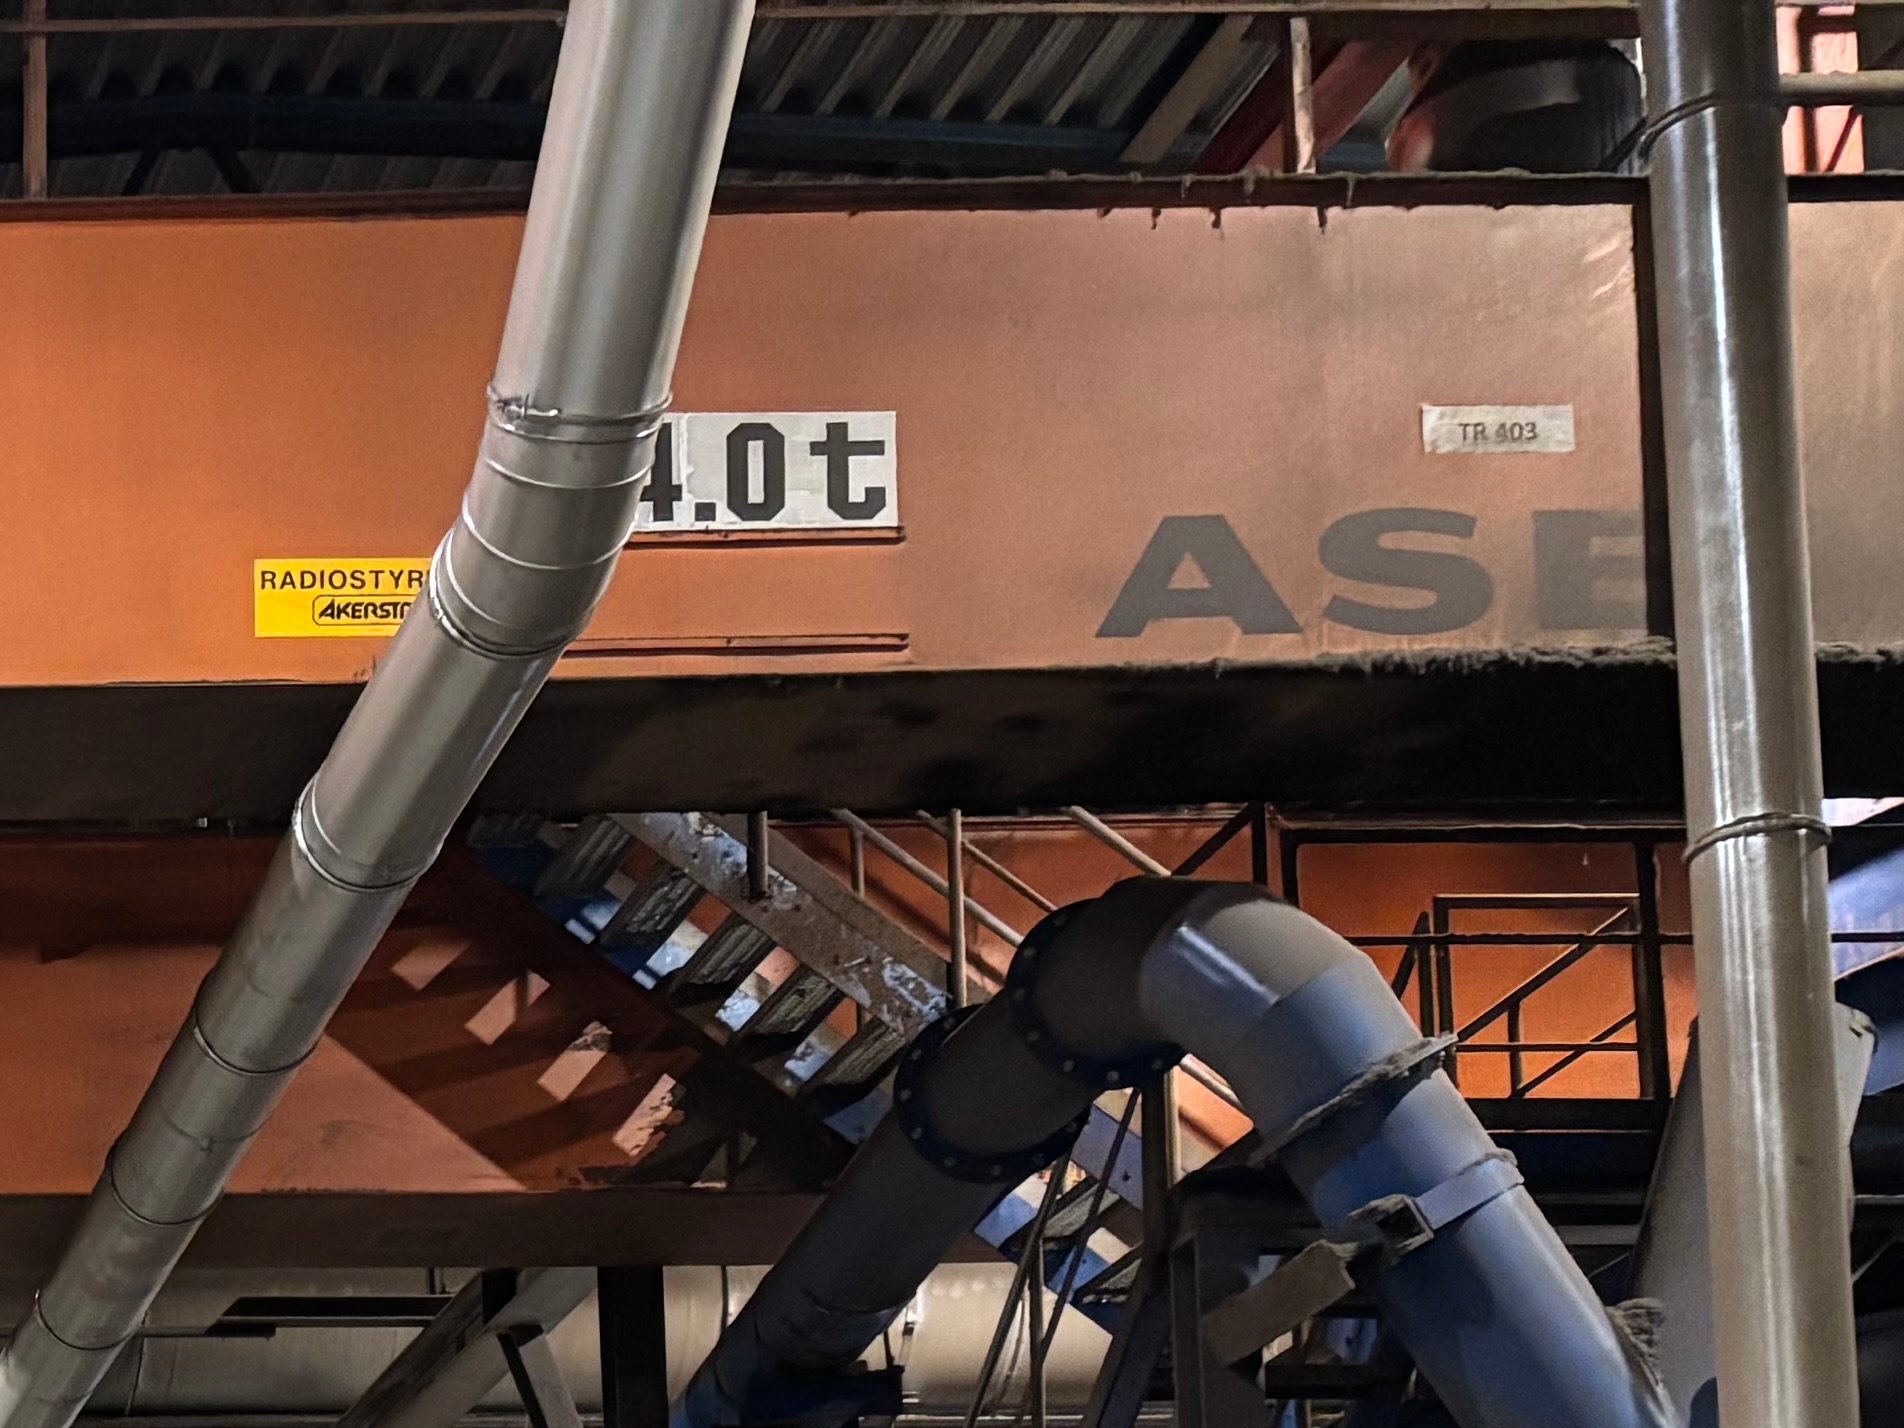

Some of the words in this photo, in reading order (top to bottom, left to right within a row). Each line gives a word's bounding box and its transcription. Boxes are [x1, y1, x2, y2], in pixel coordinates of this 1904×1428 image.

[1458, 422, 1489, 442] TR
[809, 421, 887, 521] t
[260, 569, 430, 590] RADIOSTYR
